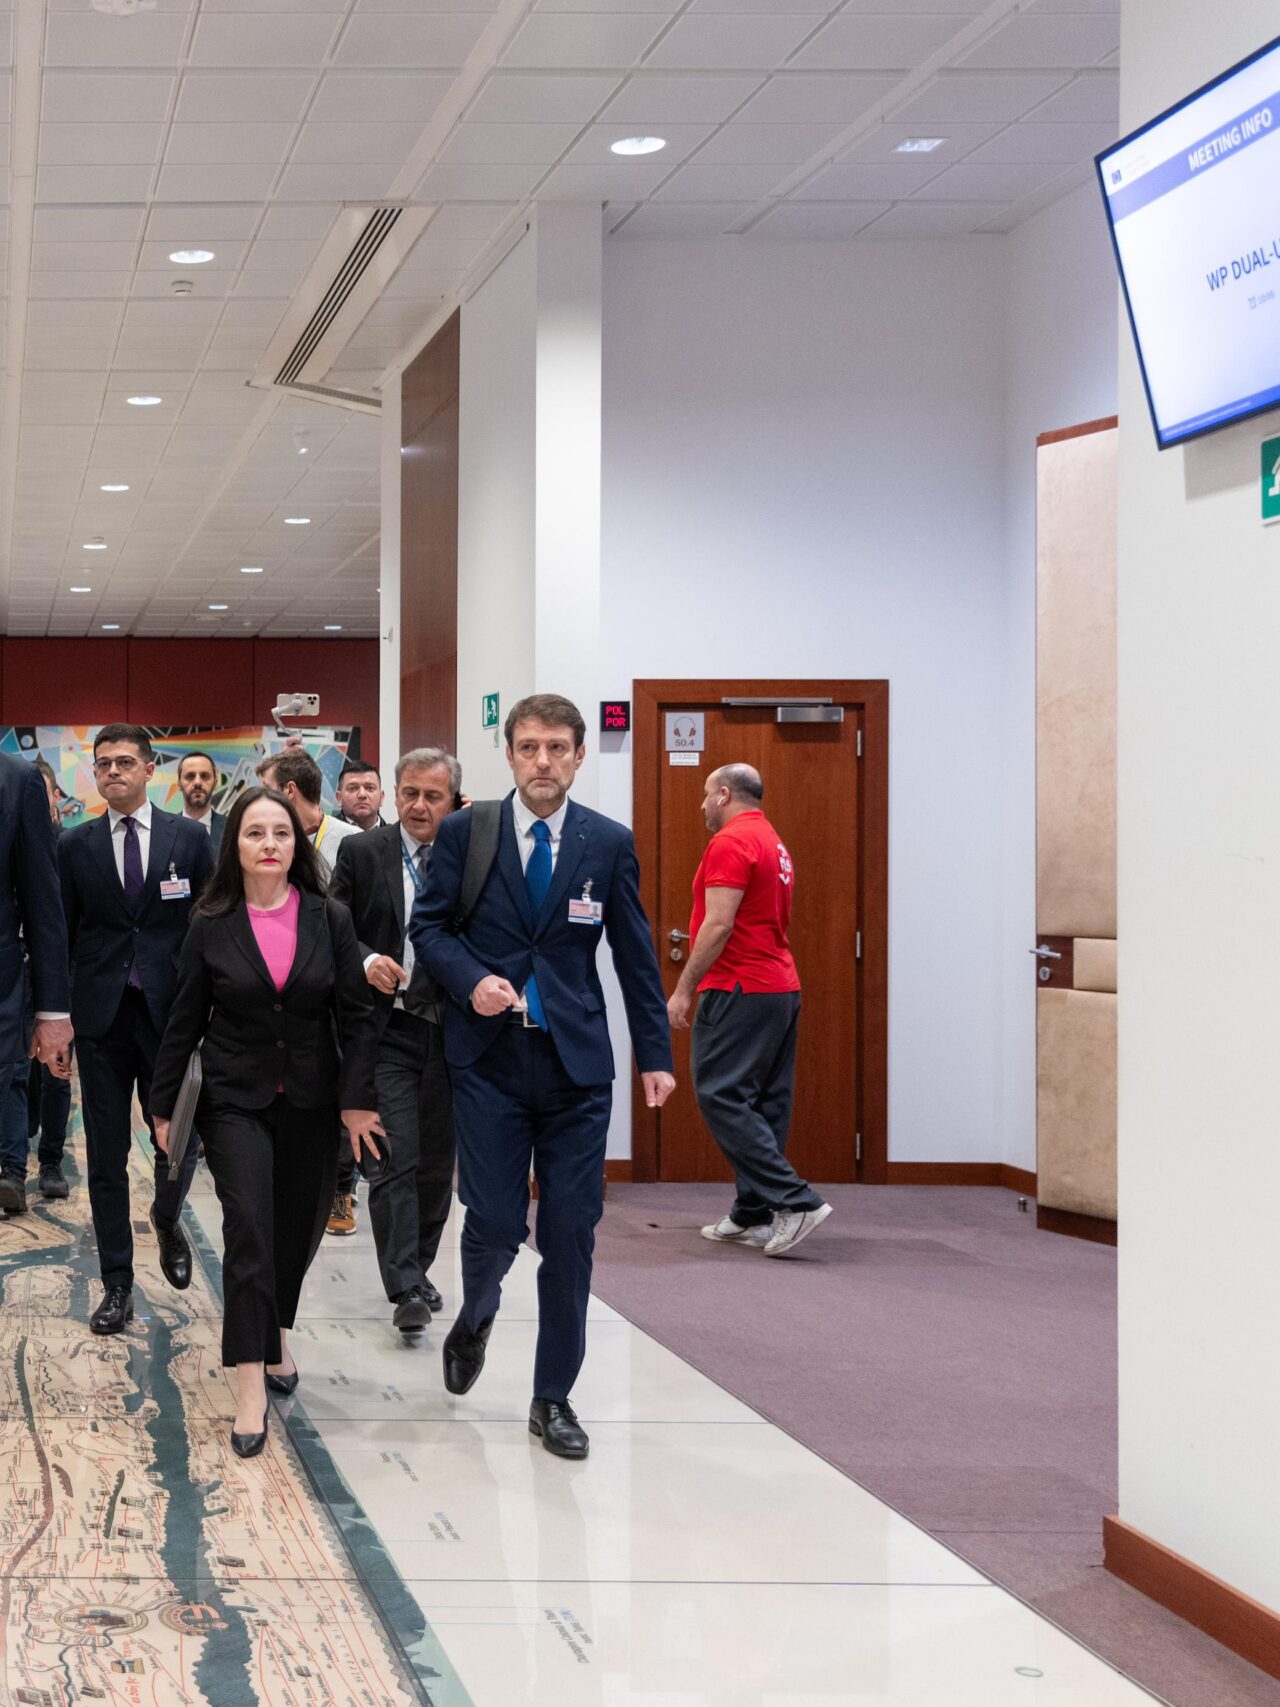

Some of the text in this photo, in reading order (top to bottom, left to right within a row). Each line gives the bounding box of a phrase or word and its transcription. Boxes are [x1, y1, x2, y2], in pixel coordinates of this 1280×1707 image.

[1187, 126, 1241, 171] MEETING
[1241, 107, 1273, 140] INFO
[1206, 238, 1280, 292] WP DUAL-U
[605, 705, 626, 716] POL
[605, 717, 626, 728] POR
[674, 738, 696, 748] 50.4
